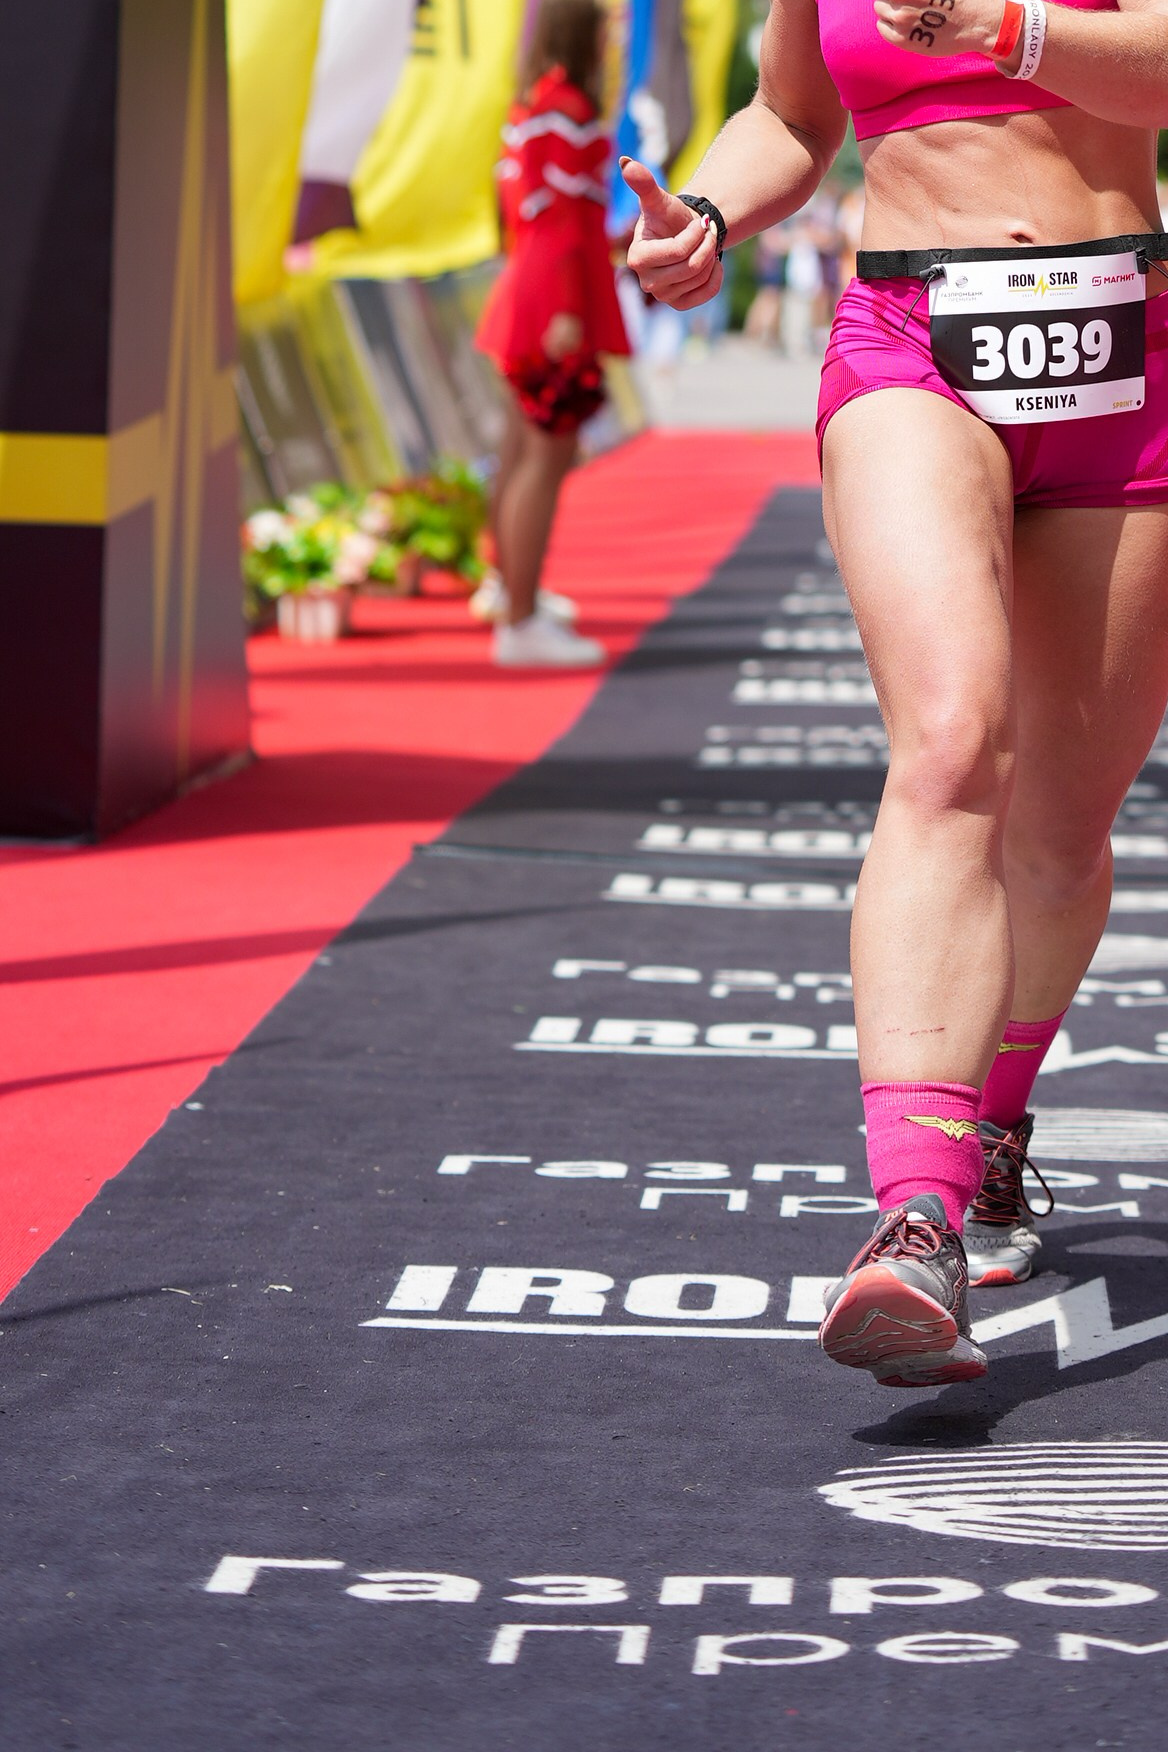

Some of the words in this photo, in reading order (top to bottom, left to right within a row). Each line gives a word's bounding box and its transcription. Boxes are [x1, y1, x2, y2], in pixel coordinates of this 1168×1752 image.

[1029, 0, 1041, 59] RONLADY
[1008, 274, 1035, 287] IRON
[1049, 271, 1078, 285] STAR
[1104, 273, 1135, 284] МАГНИТ
[971, 319, 1112, 381] 3039
[1016, 394, 1077, 411] KSENIYA
[1112, 400, 1133, 409] SPRINT
